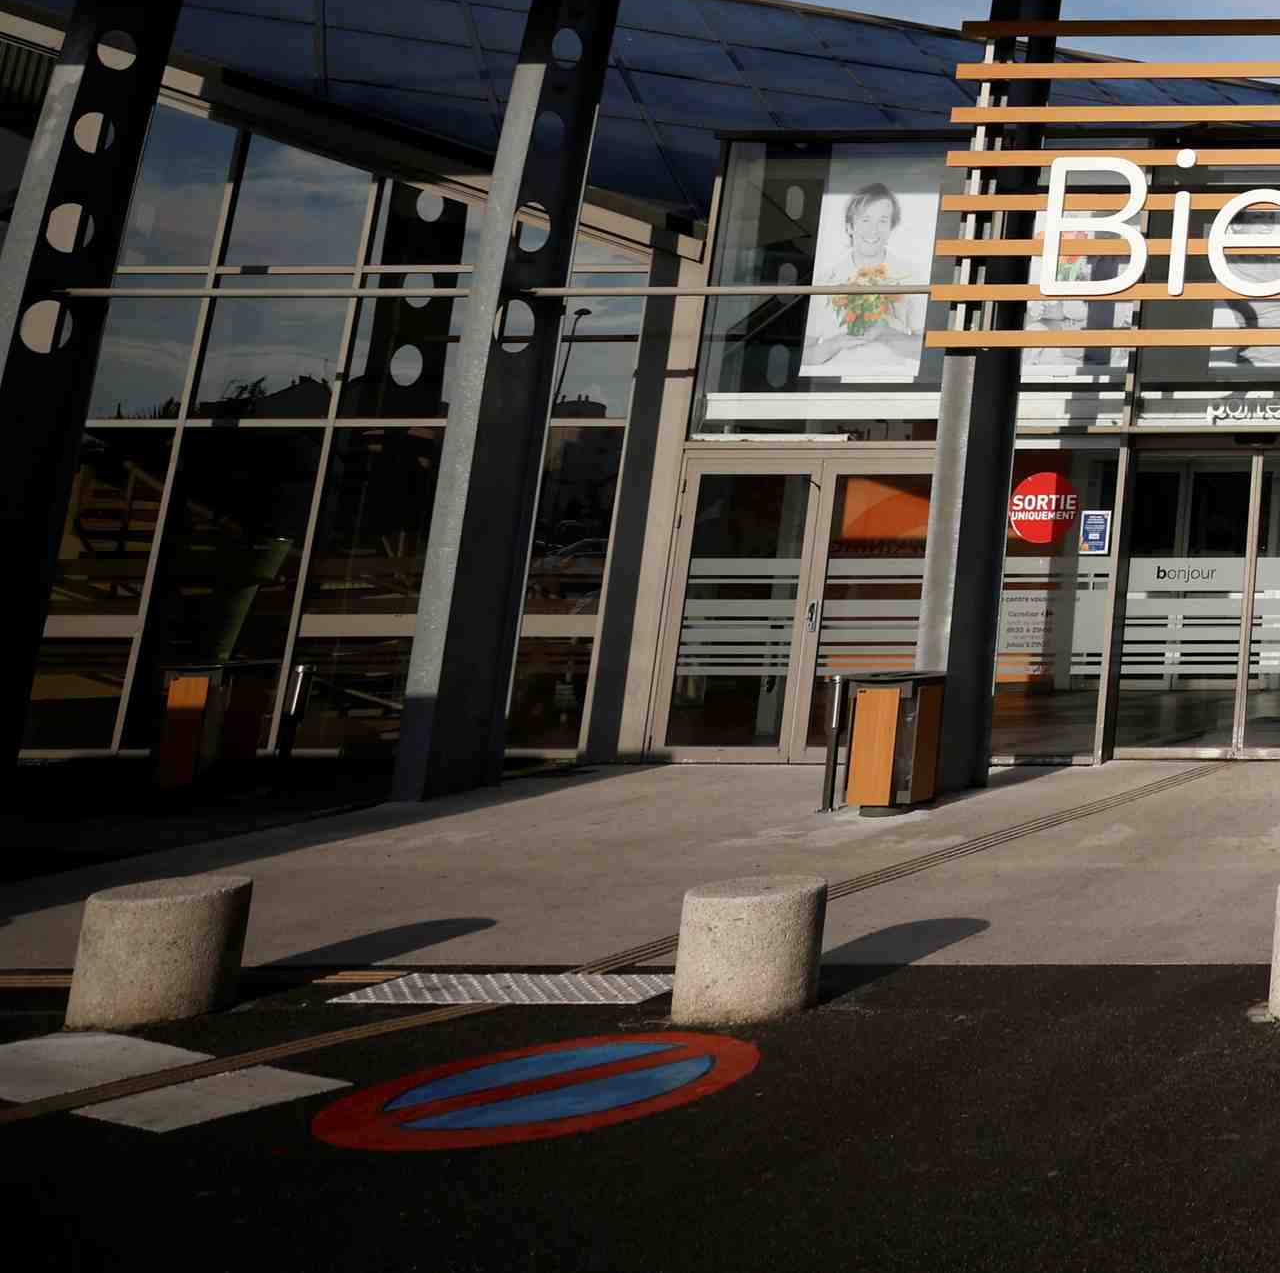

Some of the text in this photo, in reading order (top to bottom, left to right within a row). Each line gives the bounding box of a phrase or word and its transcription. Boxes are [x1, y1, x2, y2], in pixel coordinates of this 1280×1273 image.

[1011, 494, 1078, 511] SORTIE
[1009, 510, 1076, 521] UNIQUEMENT
[1155, 565, 1217, 583] bonjour
